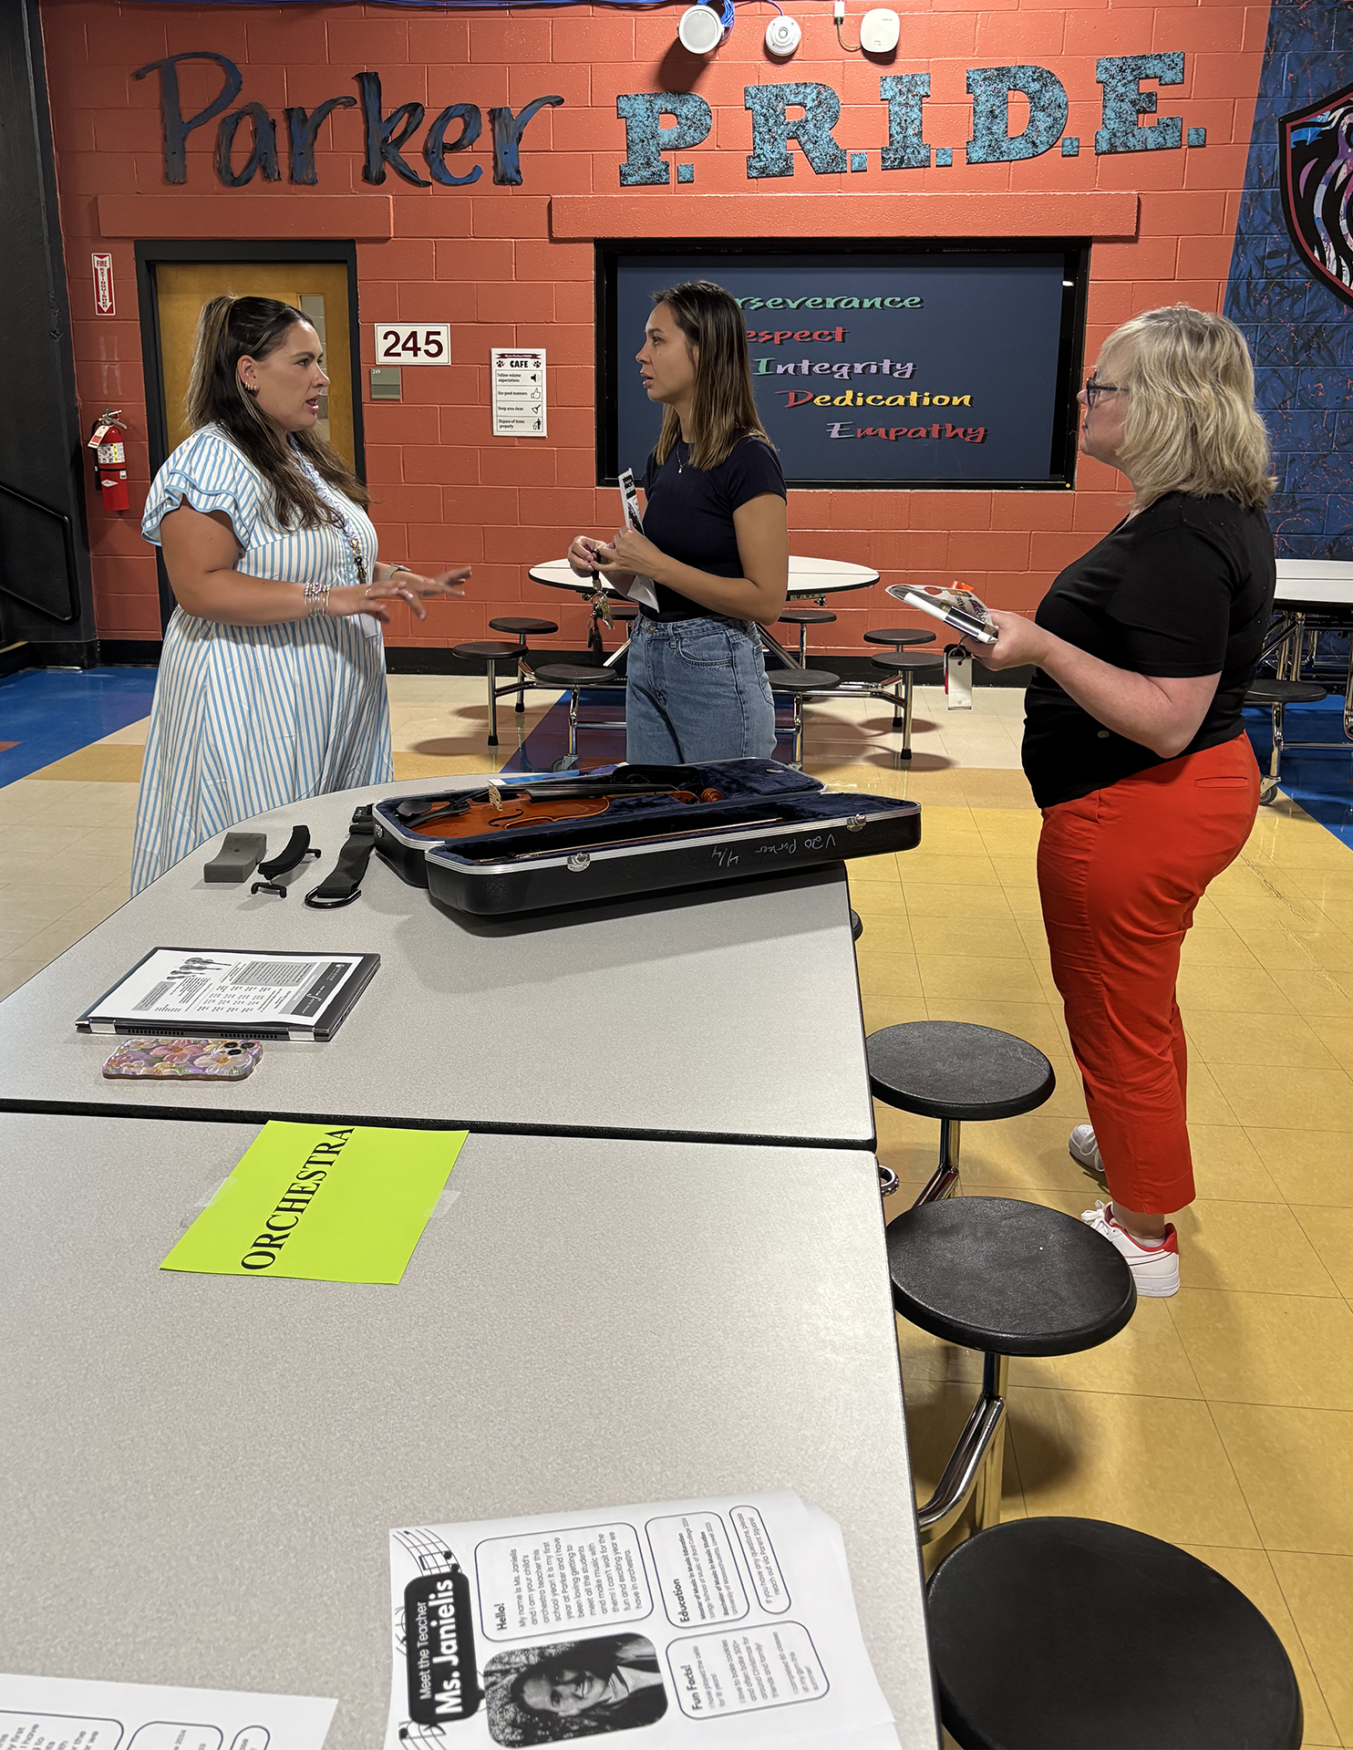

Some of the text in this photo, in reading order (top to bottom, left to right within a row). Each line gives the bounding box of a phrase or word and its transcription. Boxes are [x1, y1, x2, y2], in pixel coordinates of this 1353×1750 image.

[133, 51, 564, 186] Parker
[735, 296, 924, 310] rseverance
[383, 331, 443, 358] 245
[746, 327, 850, 345] espect
[510, 360, 528, 368] CAFE
[753, 358, 918, 380] Integrity
[774, 390, 974, 408] Dedication
[826, 421, 988, 444] Empathy
[240, 1127, 355, 1270] ORCHESTRA
[542, 1541, 550, 1554] first
[553, 1537, 561, 1553] have
[599, 1544, 607, 1554] for
[678, 1532, 689, 1556] Education
[509, 1548, 519, 1573] Janielis
[522, 1554, 531, 1576] child's
[546, 1554, 553, 1566] my
[556, 1556, 565, 1571] and
[601, 1554, 610, 1568] wait
[624, 1549, 636, 1582] orchestra.
[684, 1556, 693, 1572] Music
[566, 1544, 585, 1618] been loving getting to
[578, 1545, 596, 1616] meet all the students
[588, 1542, 608, 1614] and make music with
[604, 1569, 614, 1587] can't
[608, 1531, 631, 1611] fun and exciting year we
[525, 1576, 535, 1593] your
[532, 1548, 550, 1624] orchestra teacher this
[548, 1579, 559, 1597] year!
[559, 1571, 568, 1594] Parker
[690, 1578, 699, 1594] Music
[516, 1594, 524, 1615] name
[528, 1593, 535, 1606] am
[562, 1594, 570, 1603] at
[609, 1592, 619, 1613] them!
[633, 1591, 642, 1609] have
[673, 1578, 690, 1622] Education
[494, 1603, 507, 1630] Hello!
[529, 1610, 538, 1625] and
[550, 1598, 561, 1622] school
[564, 1603, 575, 1620] year
[697, 1600, 706, 1620] Master
[518, 1616, 527, 1627] My
[416, 1602, 432, 1700] Meet the Teacher
[428, 1579, 463, 1714] Ms. Janielis
[680, 1664, 702, 1710] Fun Facts!
